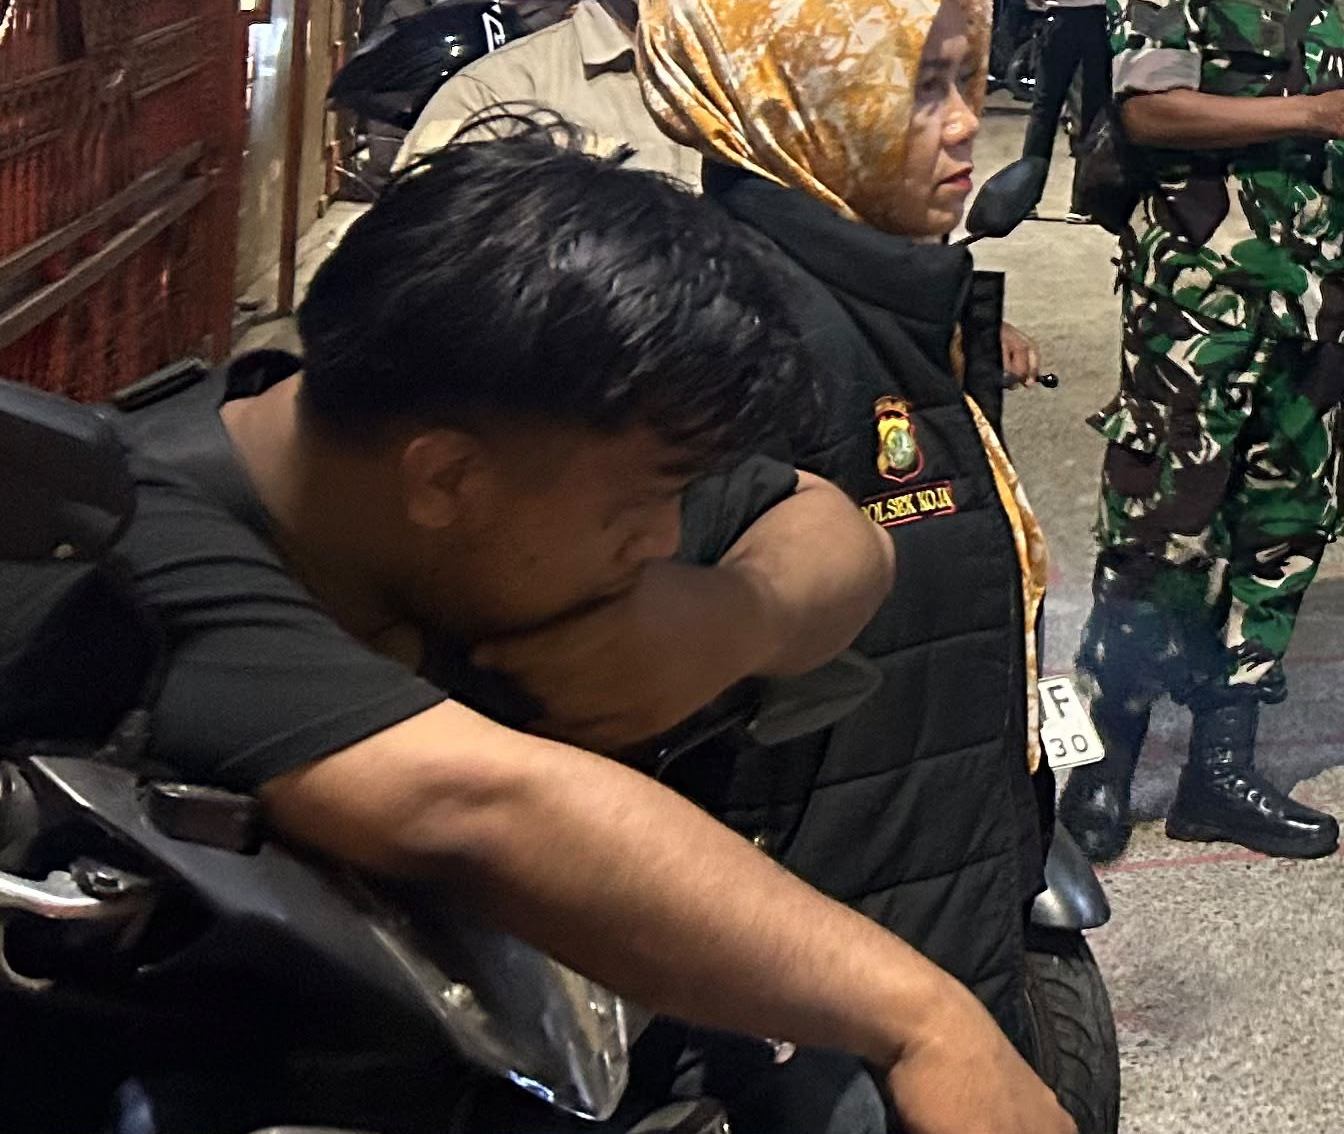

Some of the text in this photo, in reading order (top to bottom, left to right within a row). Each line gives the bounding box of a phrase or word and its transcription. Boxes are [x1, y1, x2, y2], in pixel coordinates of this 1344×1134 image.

[861, 493, 917, 522] OLSEK
[1047, 684, 1070, 719] F
[1049, 733, 1089, 758] 30
